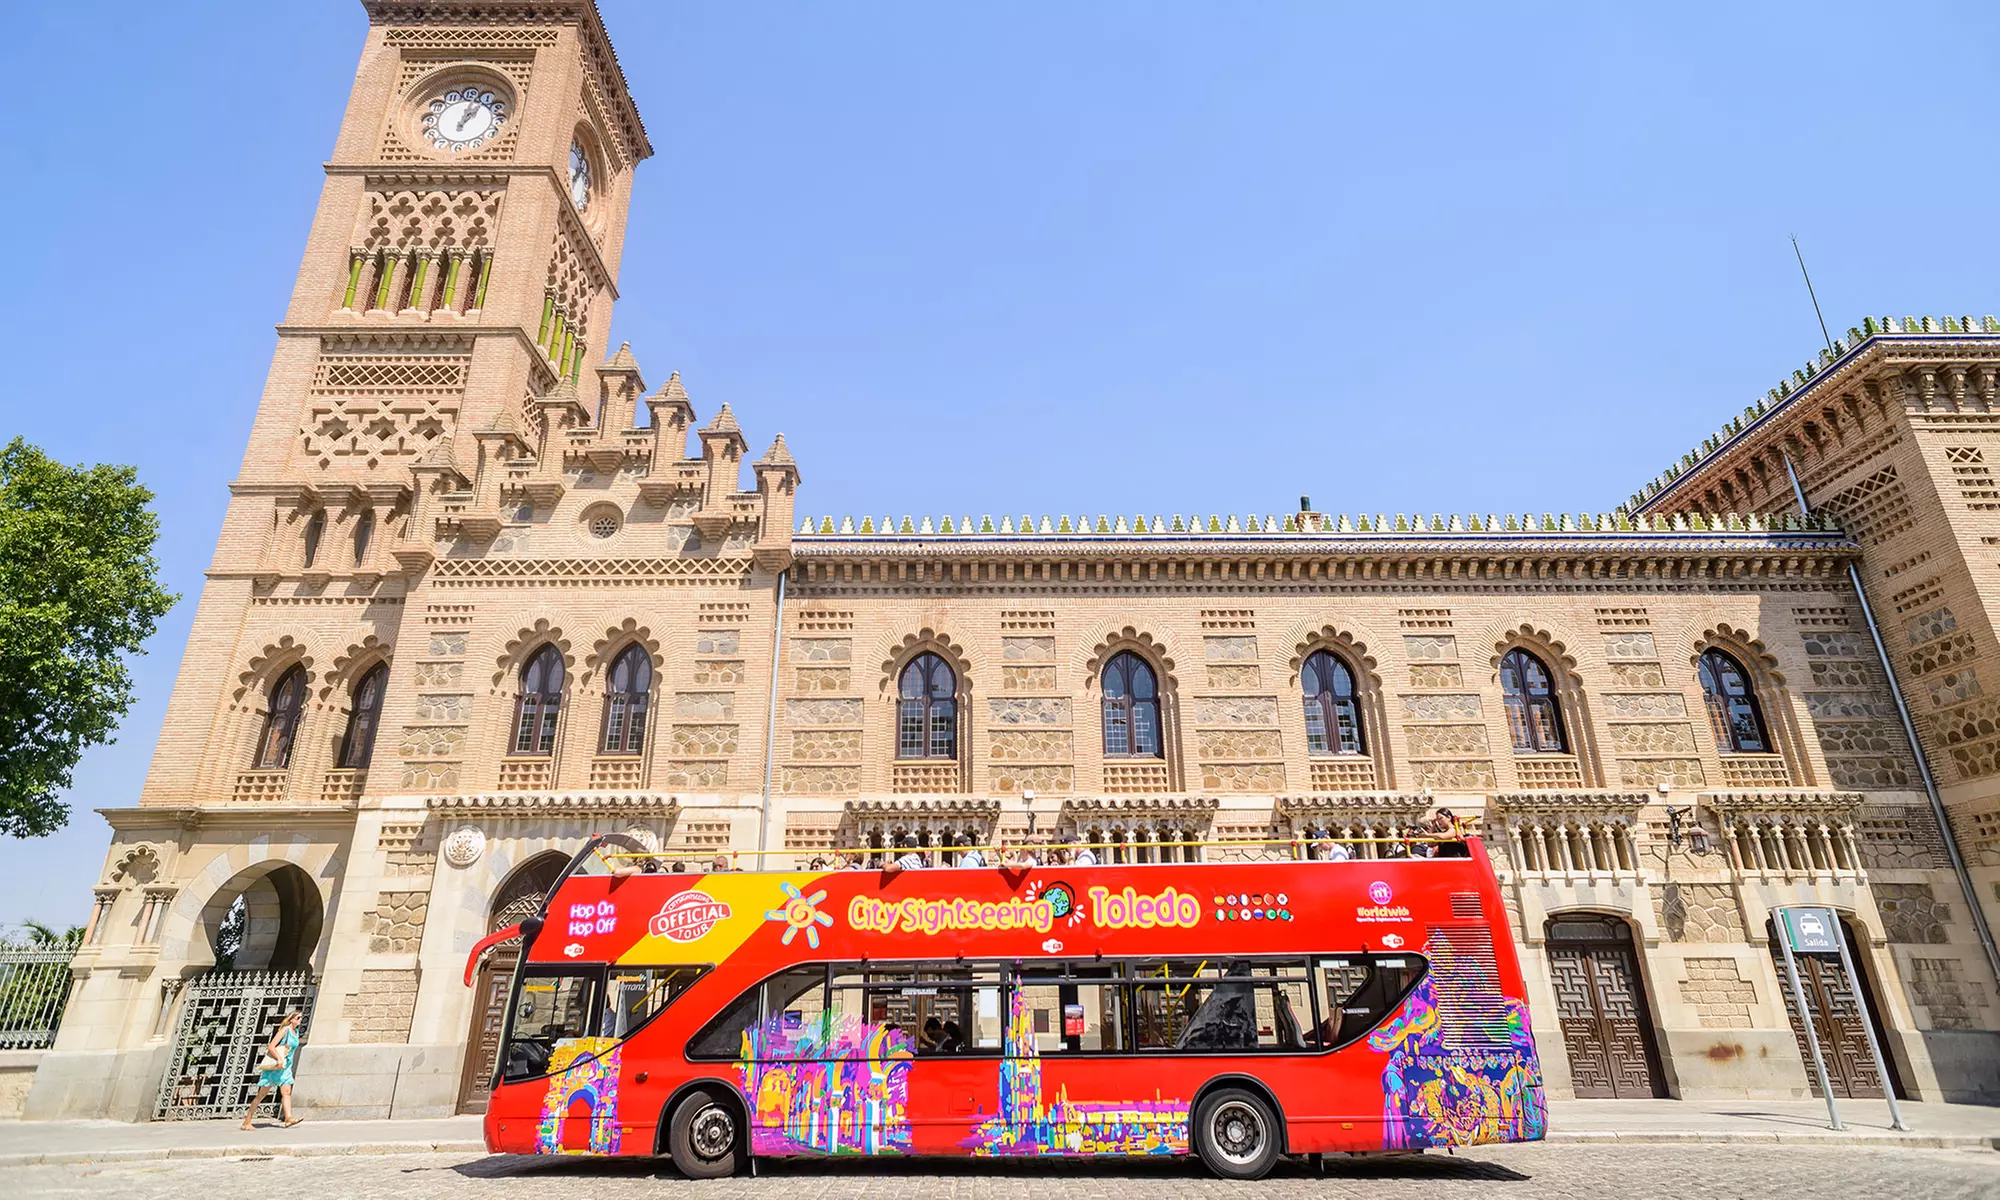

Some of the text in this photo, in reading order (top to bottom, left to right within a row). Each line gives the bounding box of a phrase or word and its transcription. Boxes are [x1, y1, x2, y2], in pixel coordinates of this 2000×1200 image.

[449, 94, 457, 102] 11
[433, 104, 443, 112] 10
[427, 117, 434, 126] 9
[438, 140, 446, 149] 7
[454, 144, 462, 152] 6
[472, 140, 481, 148] 5
[569, 900, 615, 919] Hop On
[1089, 887, 1200, 928] Toledo
[657, 904, 727, 932] OFFICIAL
[568, 917, 617, 937] Hop Off
[678, 923, 710, 939] TOUR
[1804, 938, 1828, 946] Salida
[622, 983, 646, 992] rranz
